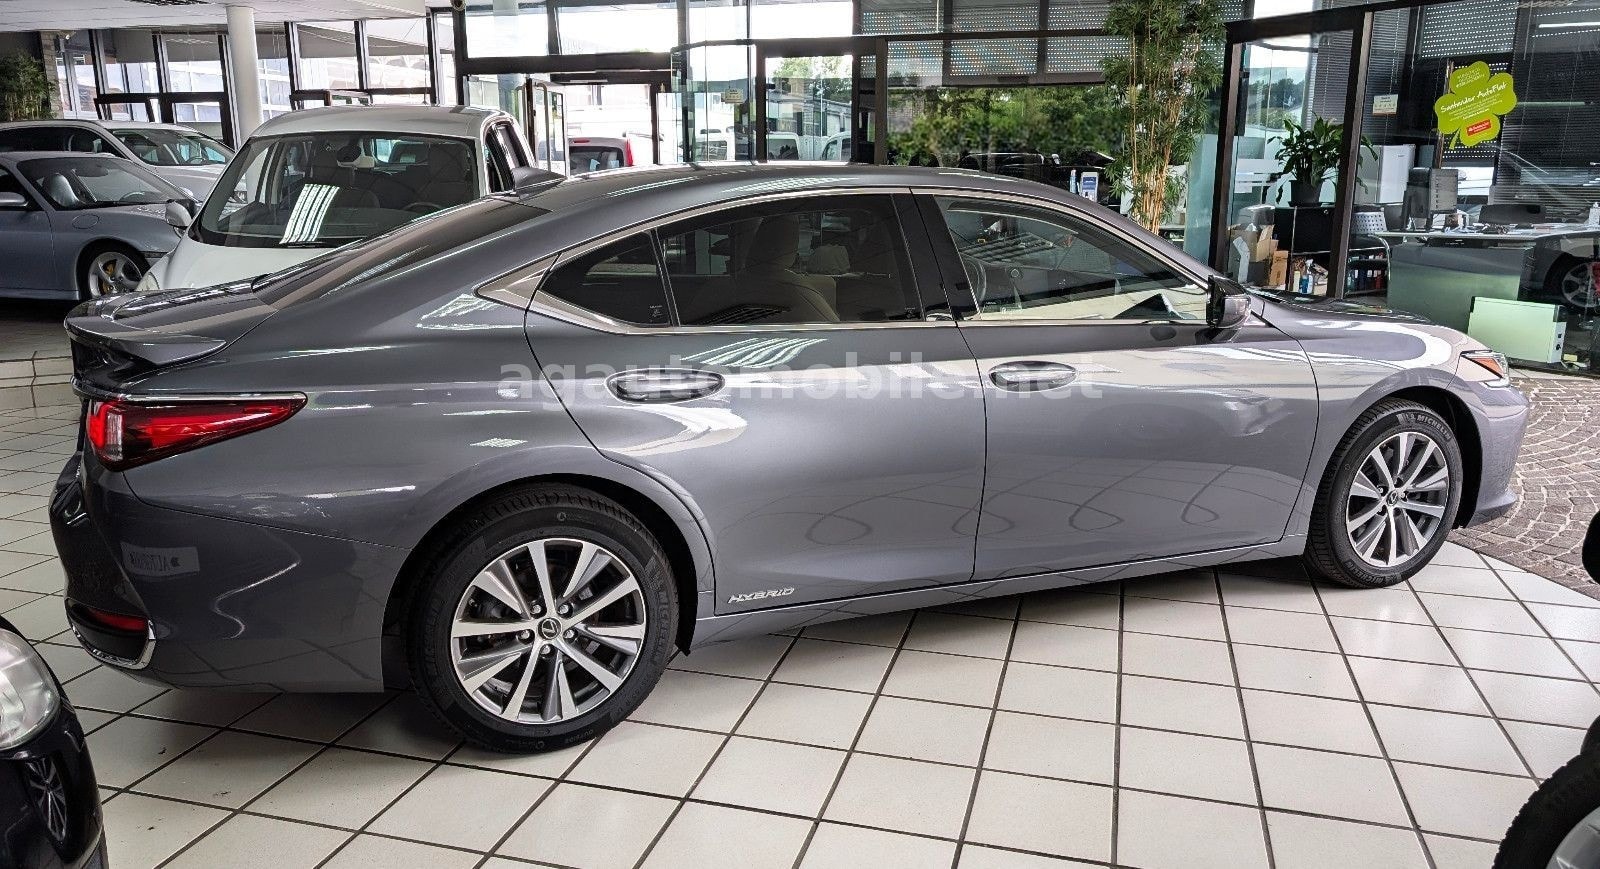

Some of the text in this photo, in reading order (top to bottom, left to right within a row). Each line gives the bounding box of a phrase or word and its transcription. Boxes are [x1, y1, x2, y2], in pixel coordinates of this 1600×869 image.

[1440, 96, 1475, 113] Santander
[1417, 414, 1451, 440] MICHELIN
[728, 587, 795, 604] HYBRID
